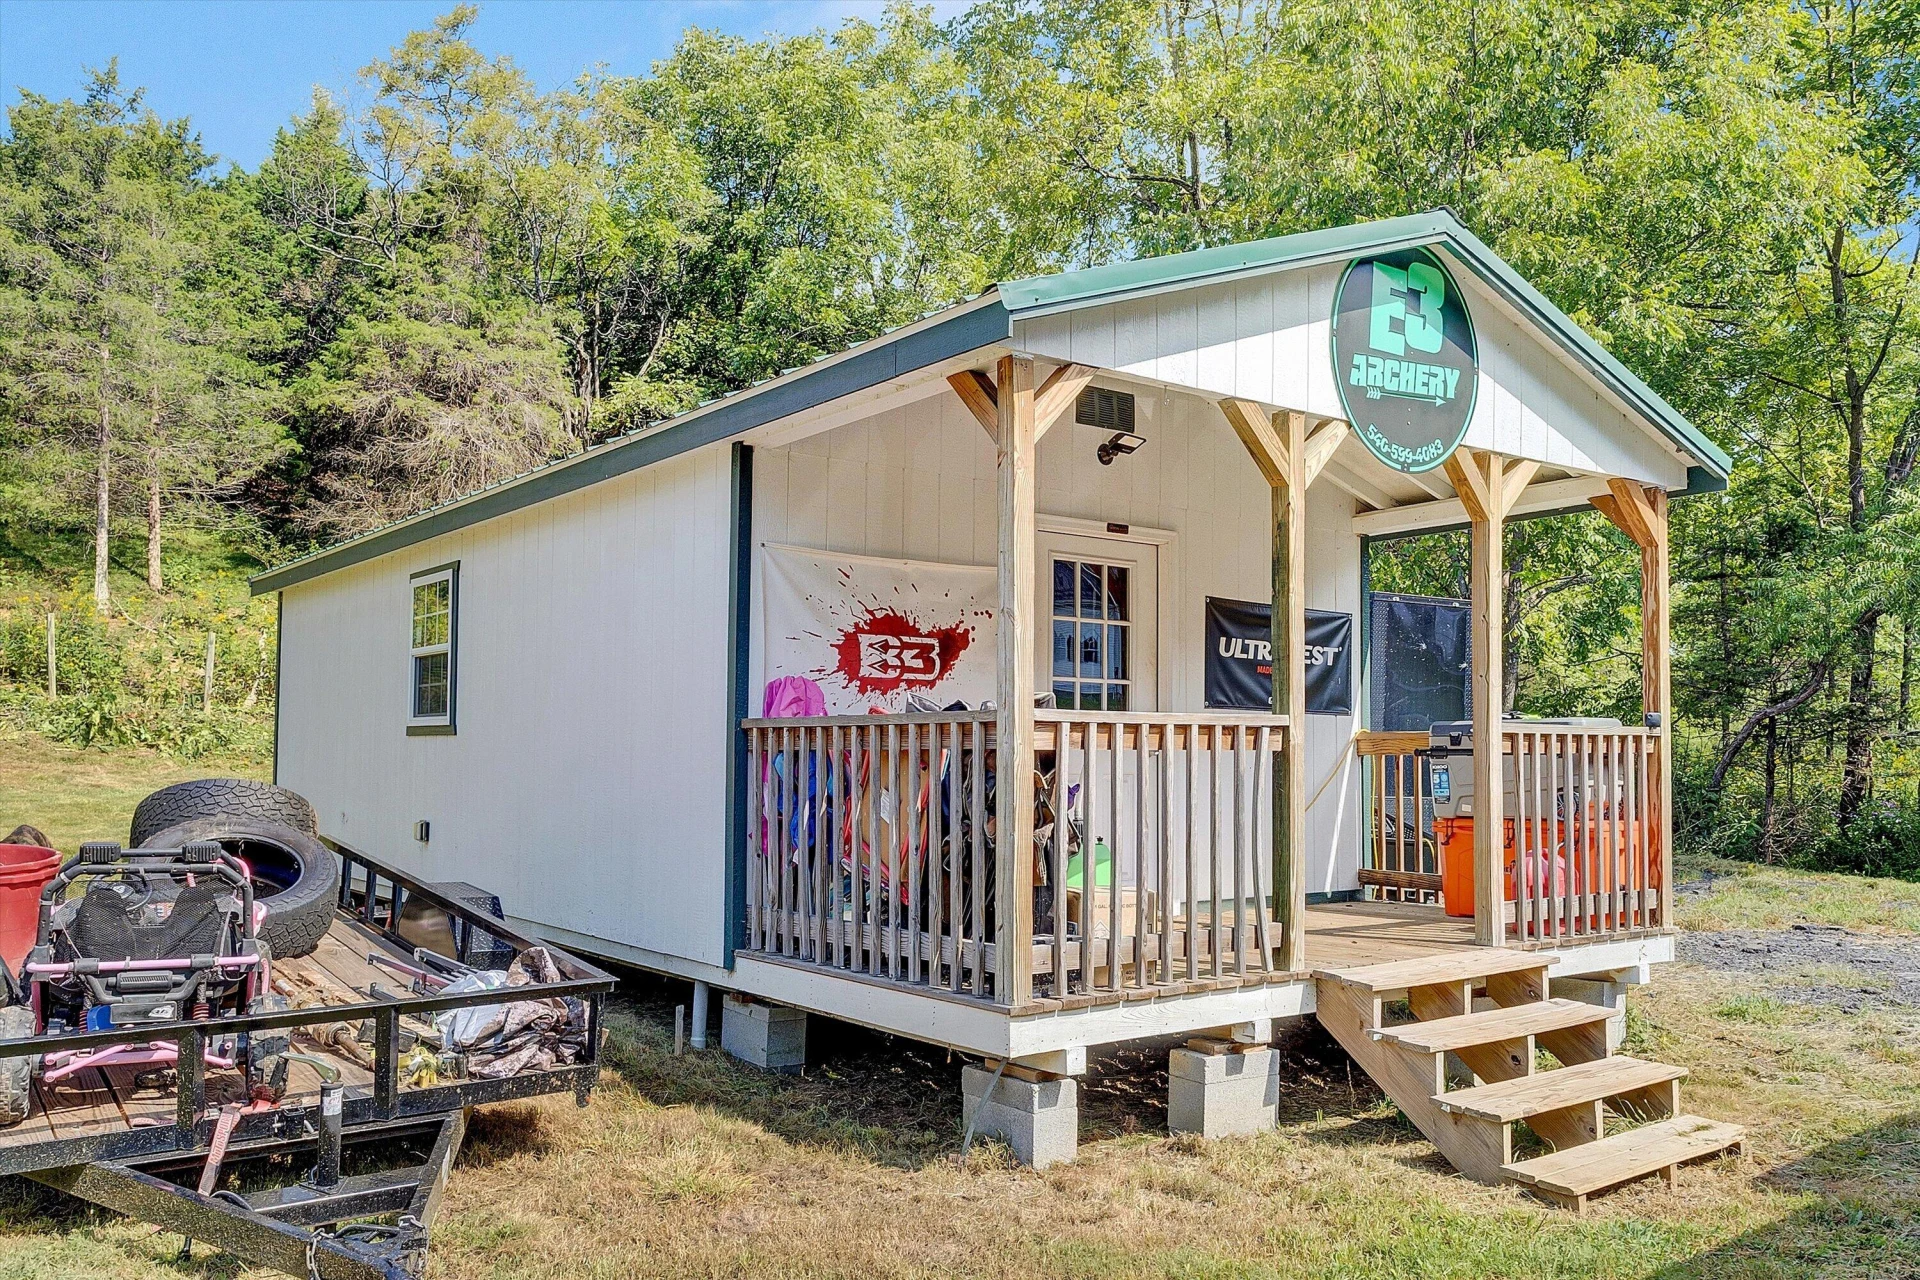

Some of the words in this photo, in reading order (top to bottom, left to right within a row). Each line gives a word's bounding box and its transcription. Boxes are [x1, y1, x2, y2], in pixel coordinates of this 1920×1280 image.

[1368, 260, 1445, 357] E3
[1350, 353, 1460, 399] ARCHERY
[1219, 636, 1339, 666] ULTREST
